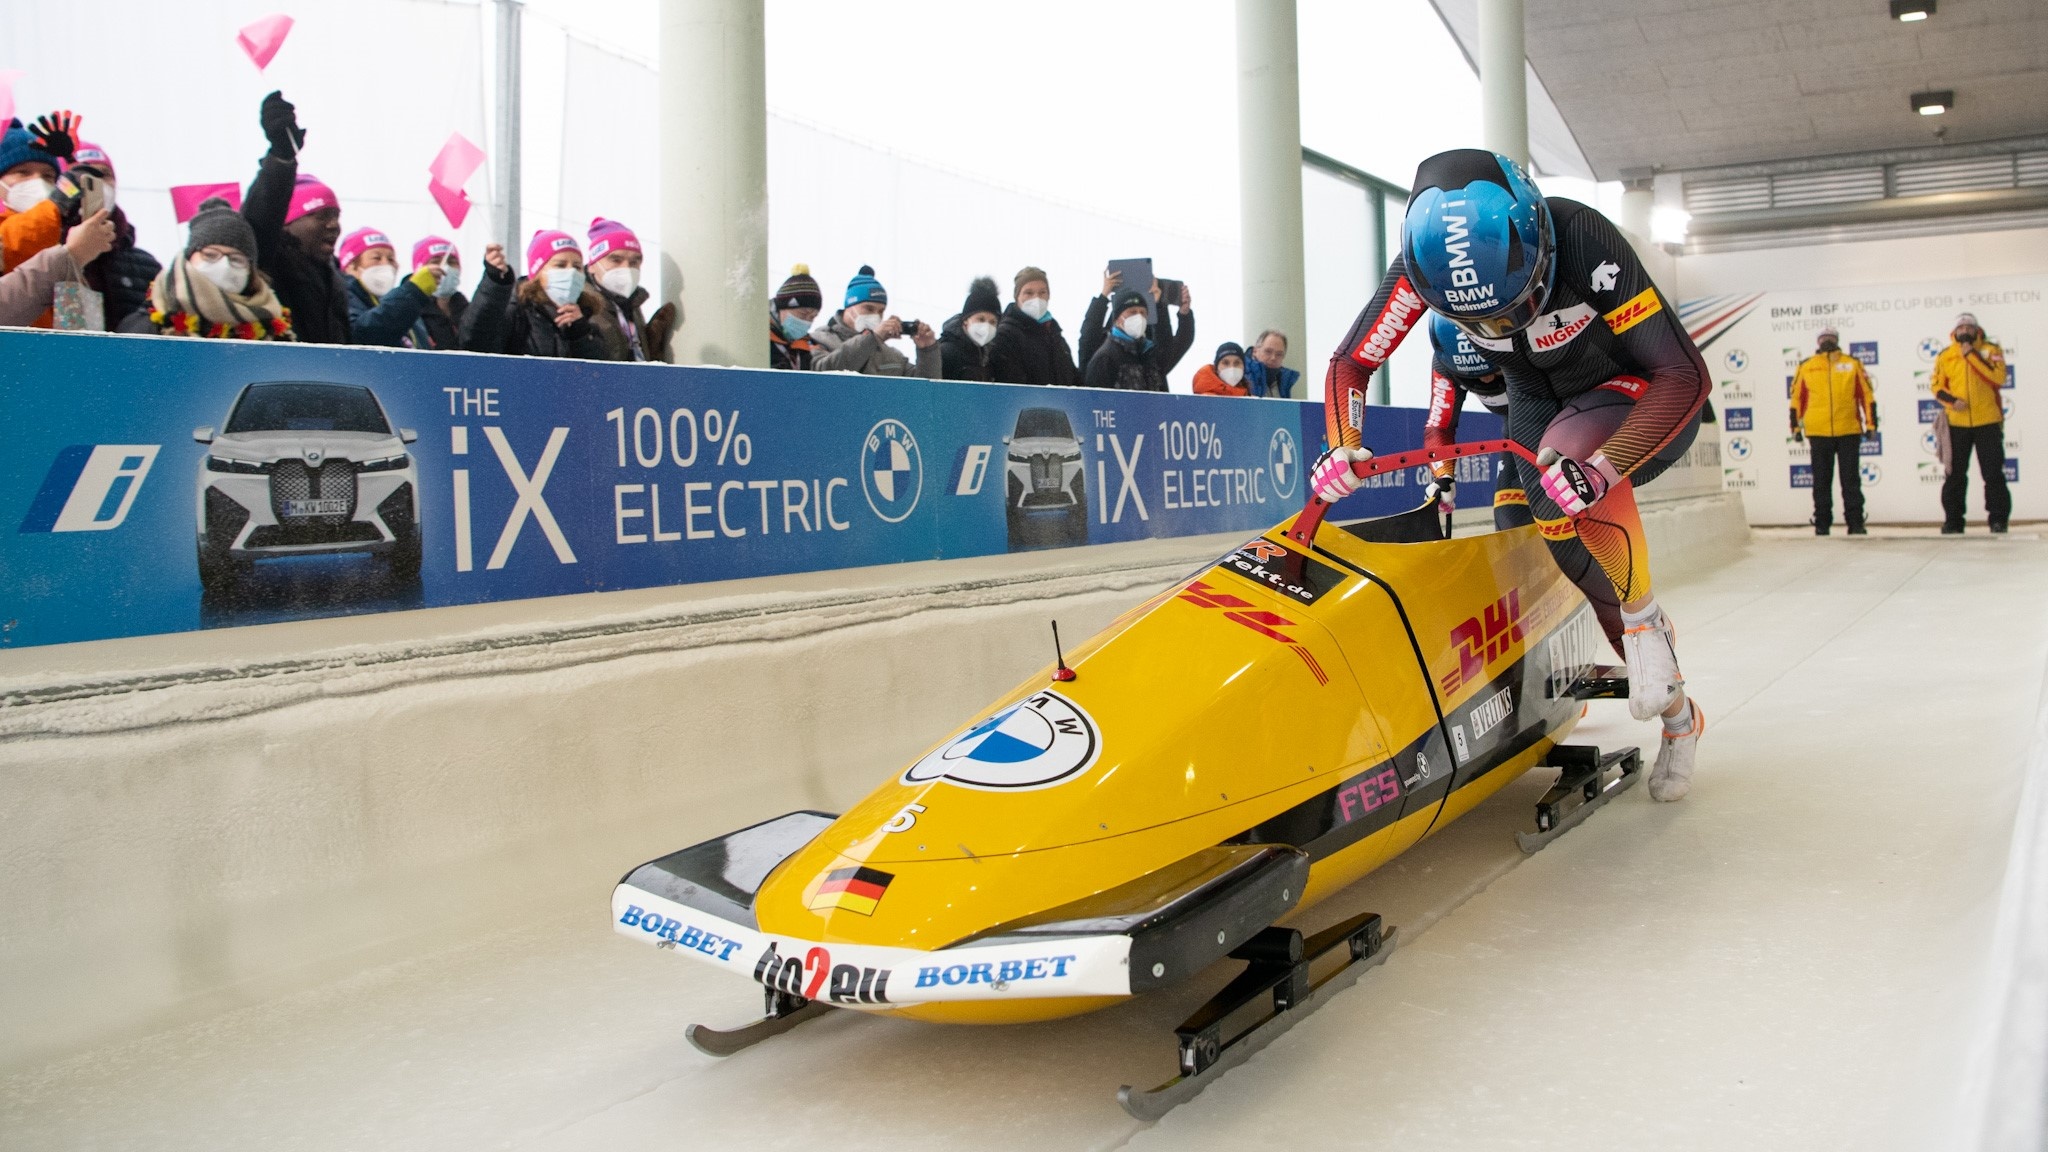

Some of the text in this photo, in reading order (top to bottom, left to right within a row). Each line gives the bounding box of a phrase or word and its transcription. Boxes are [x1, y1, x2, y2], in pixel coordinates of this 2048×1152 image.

[1442, 215, 1479, 288] BMW
[1445, 284, 1494, 303] BMW
[1451, 298, 1500, 312] helmets
[1771, 306, 1802, 318] BMW
[1810, 303, 1839, 315] IBSF
[1844, 301, 1891, 314] WORLD
[1894, 298, 1920, 311] CUP
[1924, 295, 1953, 309] BOB
[1968, 289, 2041, 306] SKELETON
[1535, 314, 1591, 349] NIGRIN
[1606, 301, 1648, 330] DHL
[1771, 316, 1855, 332] WINTERBERG
[1452, 353, 1486, 365] BMW
[1456, 363, 1490, 373] helmets
[443, 387, 500, 416] THE
[1092, 410, 1116, 429] THE
[606, 406, 753, 468] 100%
[869, 424, 914, 453] BMW
[1158, 421, 1222, 461] 100%
[1097, 434, 1149, 524] iX
[1163, 468, 1266, 510] ELECTRIC
[1568, 463, 1589, 496] SEIZ
[451, 426, 578, 572] iX
[614, 477, 851, 545] ELECTRIC
[1450, 587, 1530, 687] DHL
[1477, 687, 1513, 733] VELTINS
[1457, 732, 1464, 747] 5
[1338, 767, 1400, 823] FES
[881, 802, 928, 834] 5
[619, 904, 743, 961] BORBET
[914, 954, 1077, 989] BORBET
